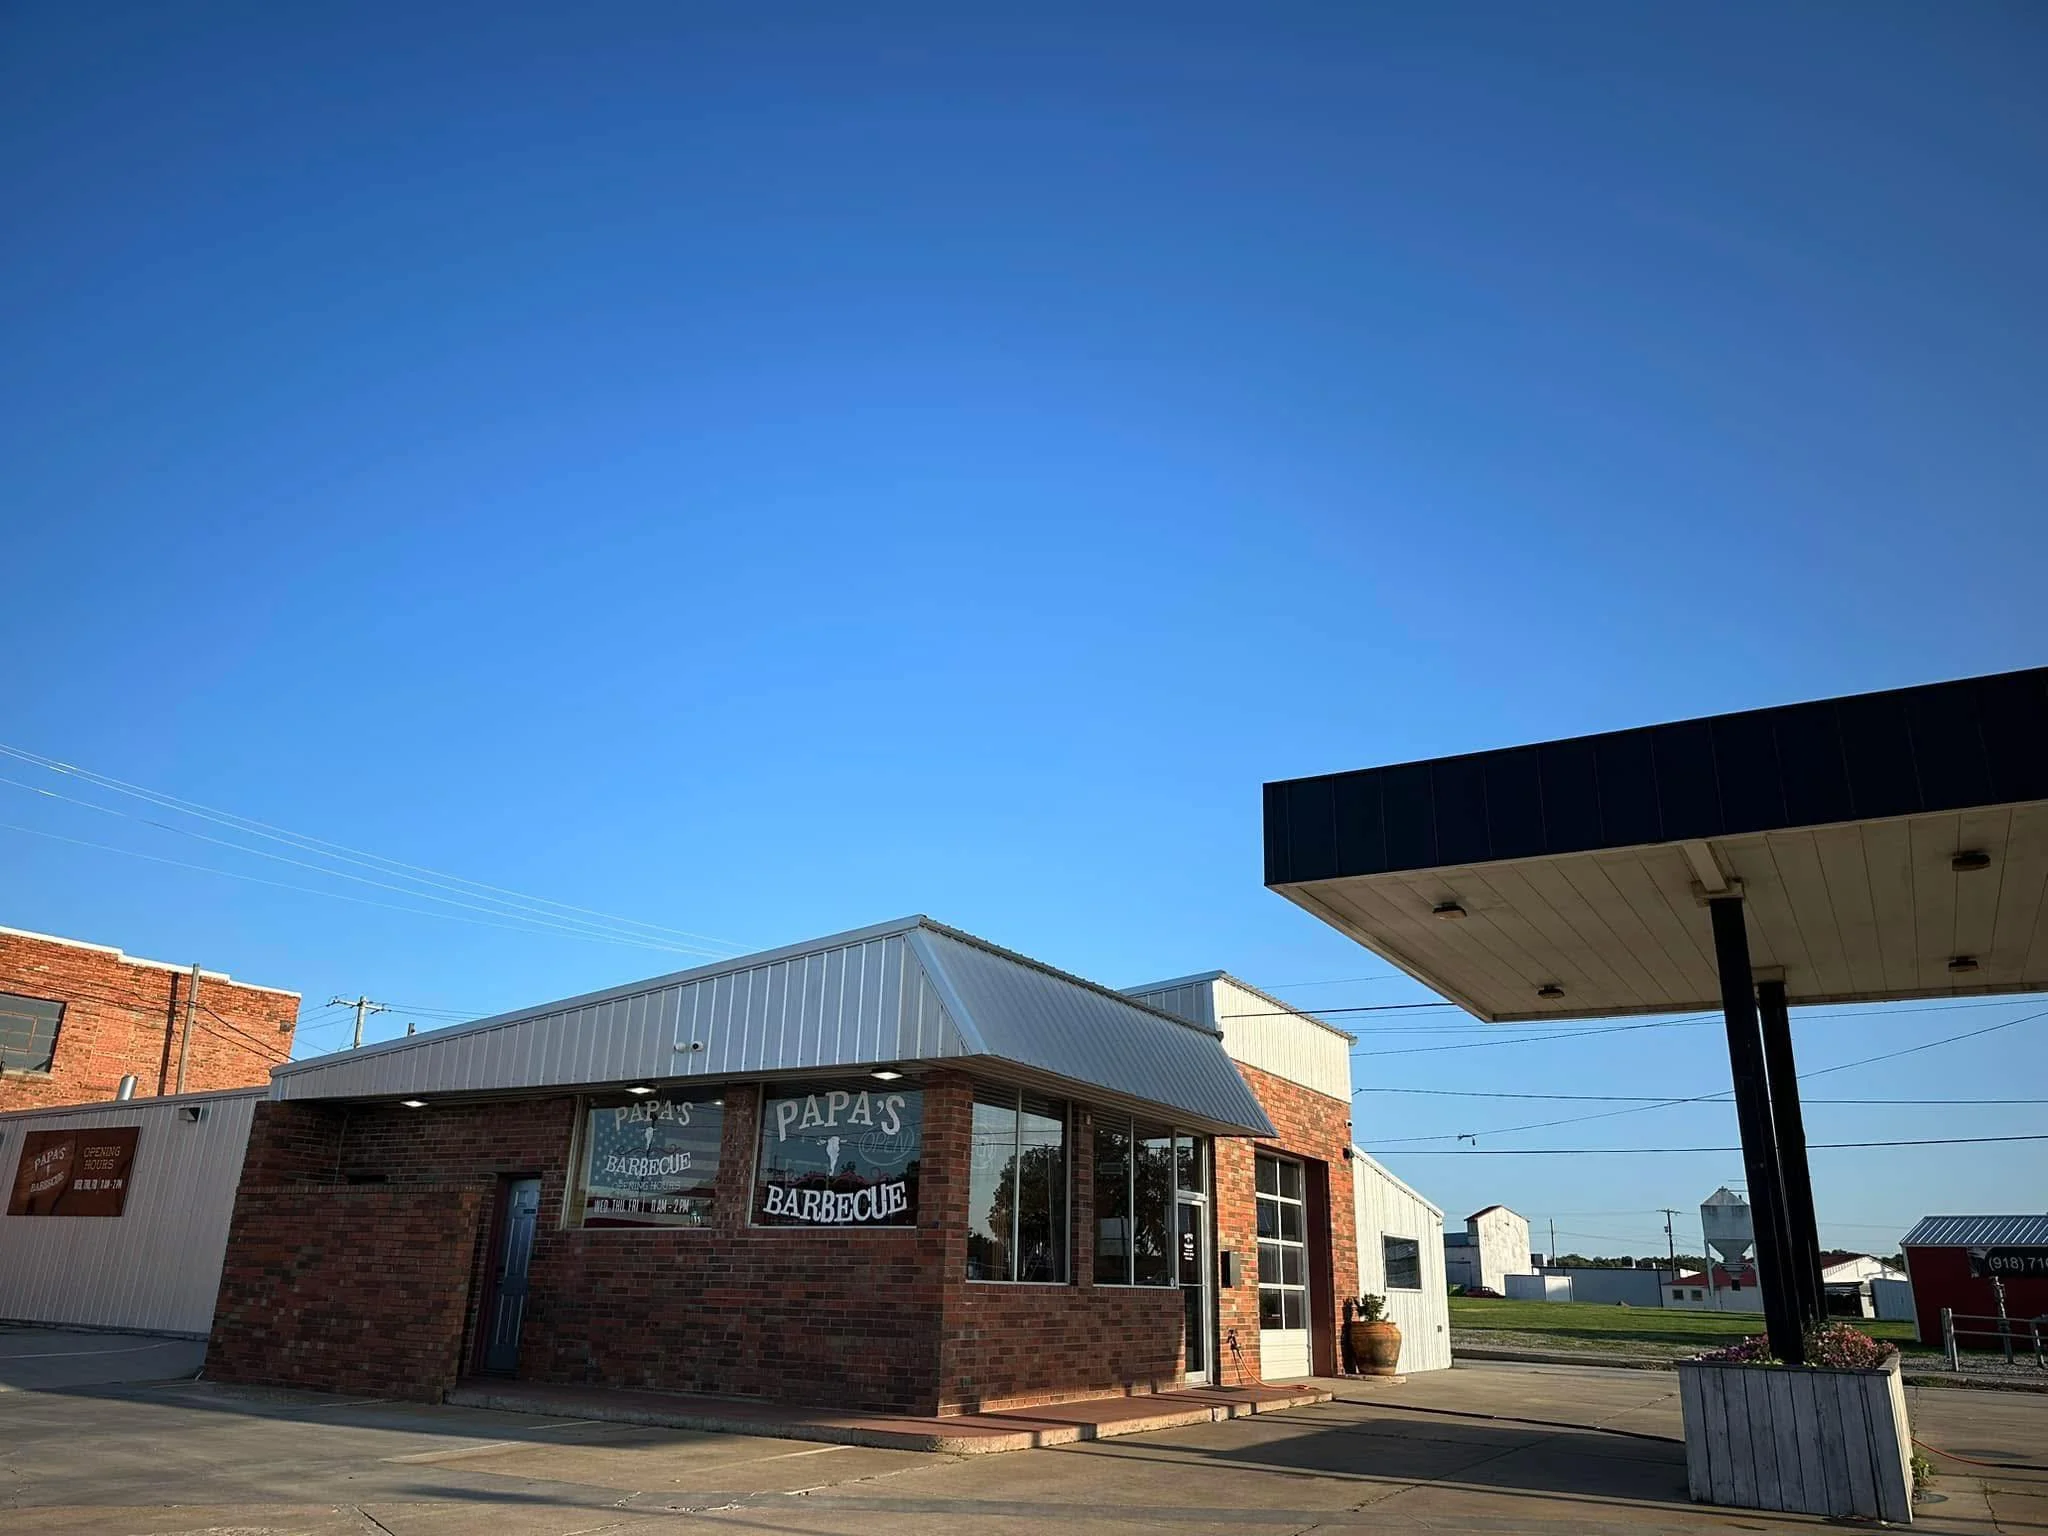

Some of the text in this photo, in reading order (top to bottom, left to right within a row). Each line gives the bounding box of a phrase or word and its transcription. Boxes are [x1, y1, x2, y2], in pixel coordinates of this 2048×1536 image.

[614, 1099, 694, 1131] PAPA'S
[776, 1090, 906, 1142] PAPA'S
[83, 1146, 121, 1158] OPENING
[862, 1131, 910, 1153] OPEN
[84, 1159, 114, 1170] HOURS
[605, 1152, 692, 1177] BARBECUE
[763, 1181, 908, 1224] BARBECUE
[1988, 1256, 2024, 1272] (918)
